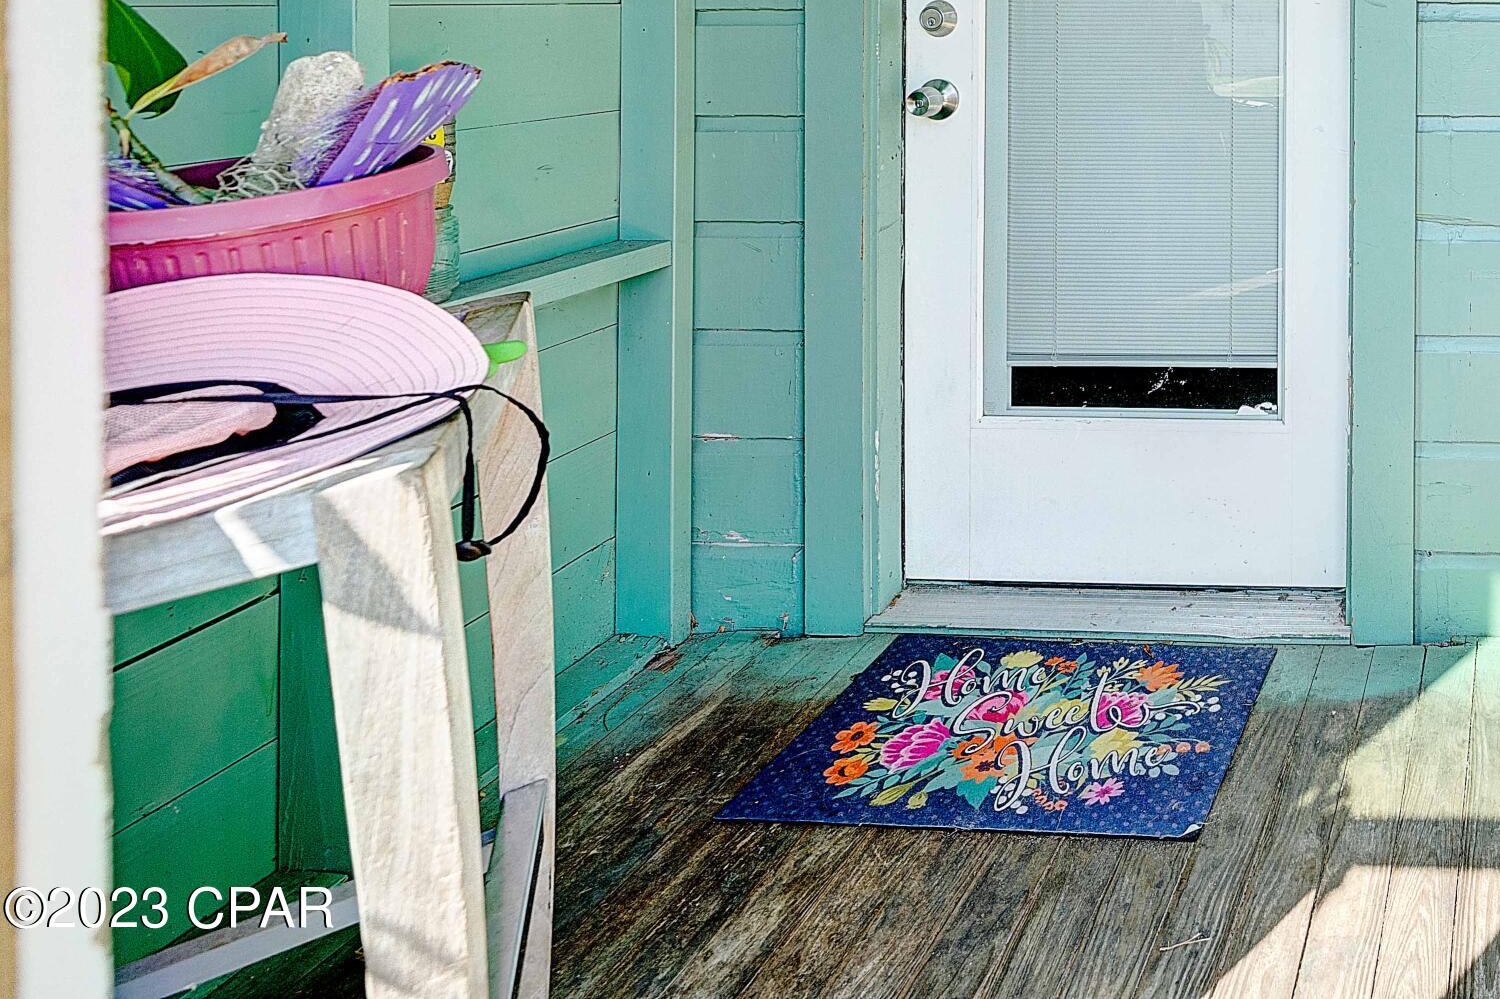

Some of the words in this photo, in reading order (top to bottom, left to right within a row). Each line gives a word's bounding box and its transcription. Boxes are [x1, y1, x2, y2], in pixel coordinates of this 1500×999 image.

[892, 648, 1056, 718] Home
[952, 672, 1200, 753] Sweet
[994, 726, 1171, 812] Home
